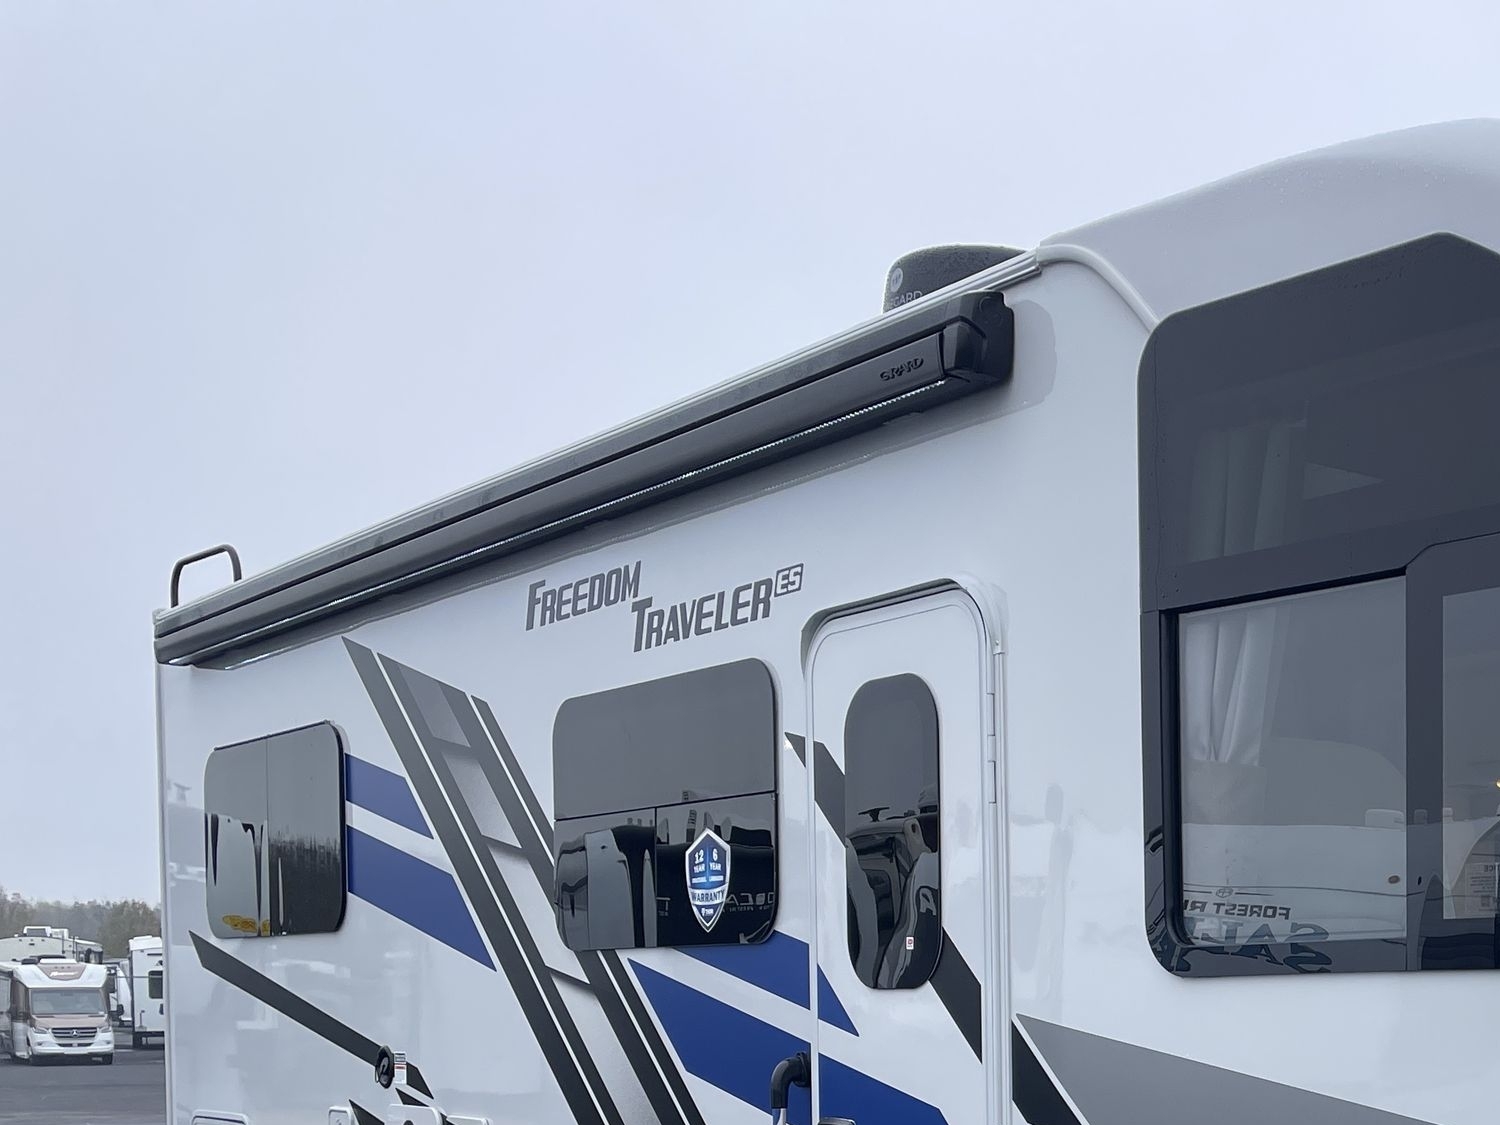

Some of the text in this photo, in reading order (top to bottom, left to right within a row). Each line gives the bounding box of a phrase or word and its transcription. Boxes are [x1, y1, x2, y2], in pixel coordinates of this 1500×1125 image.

[525, 560, 642, 632] FREEDOM
[631, 566, 802, 653] TRAVELER ES
[694, 849, 704, 864] 12
[712, 848, 718, 861] 6
[709, 862, 722, 871] YEAR
[692, 889, 725, 903] WARRANTY
